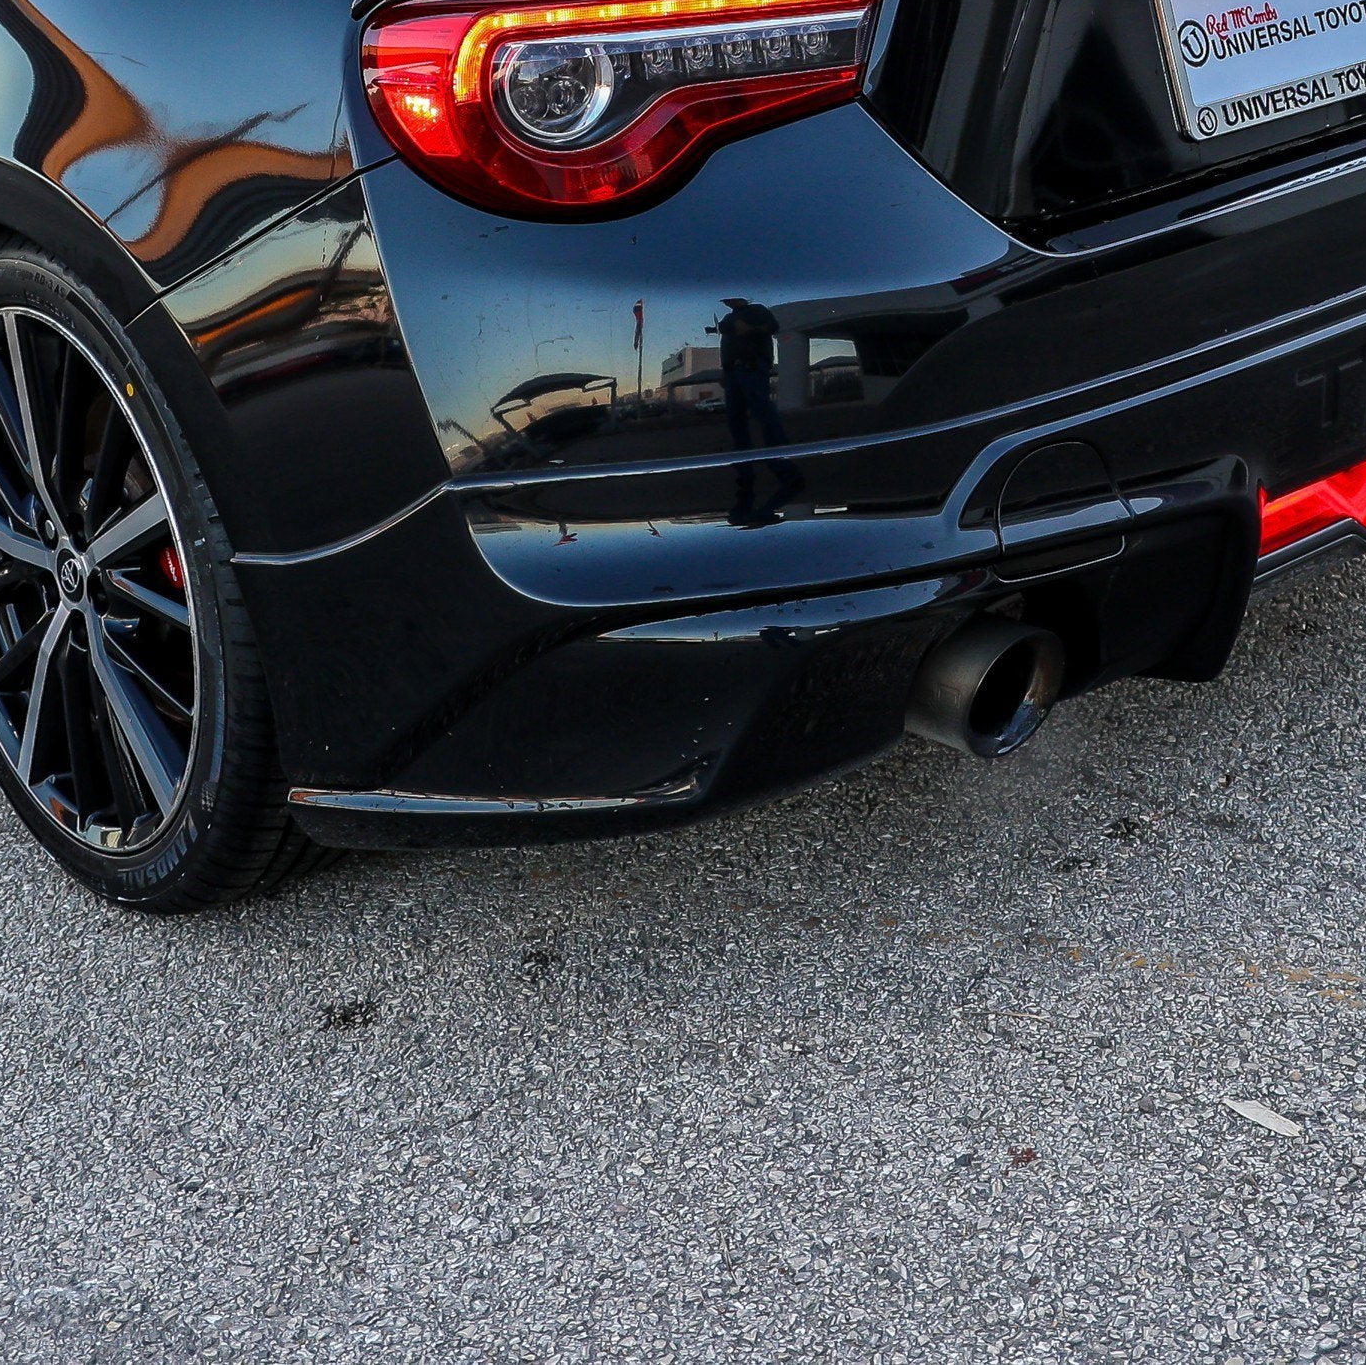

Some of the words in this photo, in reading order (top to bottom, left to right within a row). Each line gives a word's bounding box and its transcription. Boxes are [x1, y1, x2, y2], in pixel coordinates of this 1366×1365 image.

[1206, 13, 1229, 40] Red
[1227, 2, 1278, 29] McCombs
[1212, 15, 1316, 60] UNIVERSAL
[1222, 76, 1336, 127] UNIVERSAL
[117, 809, 197, 889] LANDSAIL
